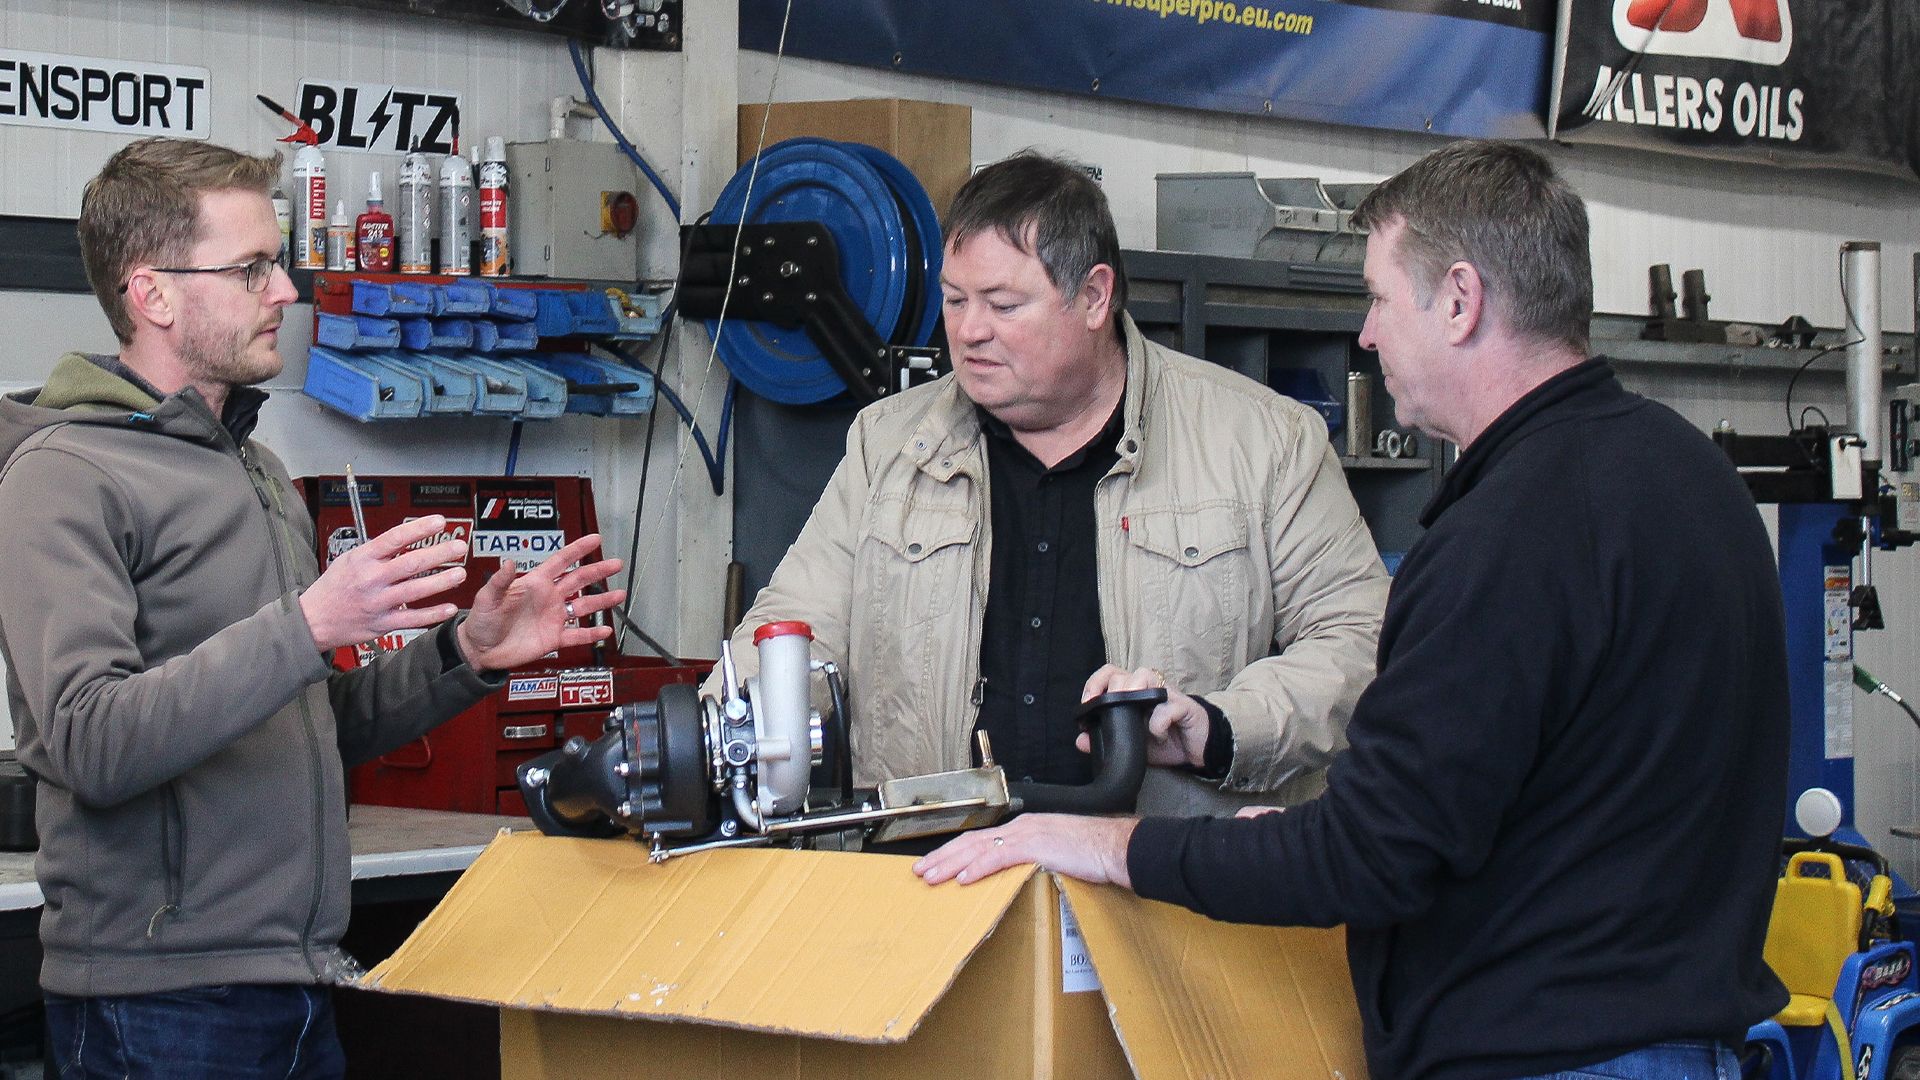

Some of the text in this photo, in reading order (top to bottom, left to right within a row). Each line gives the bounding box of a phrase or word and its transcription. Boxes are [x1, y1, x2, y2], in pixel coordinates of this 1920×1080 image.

[297, 84, 458, 153] BLITZ
[1732, 82, 1804, 142] OILS
[508, 506, 554, 519] TRD
[511, 681, 556, 693] RAMAIR
